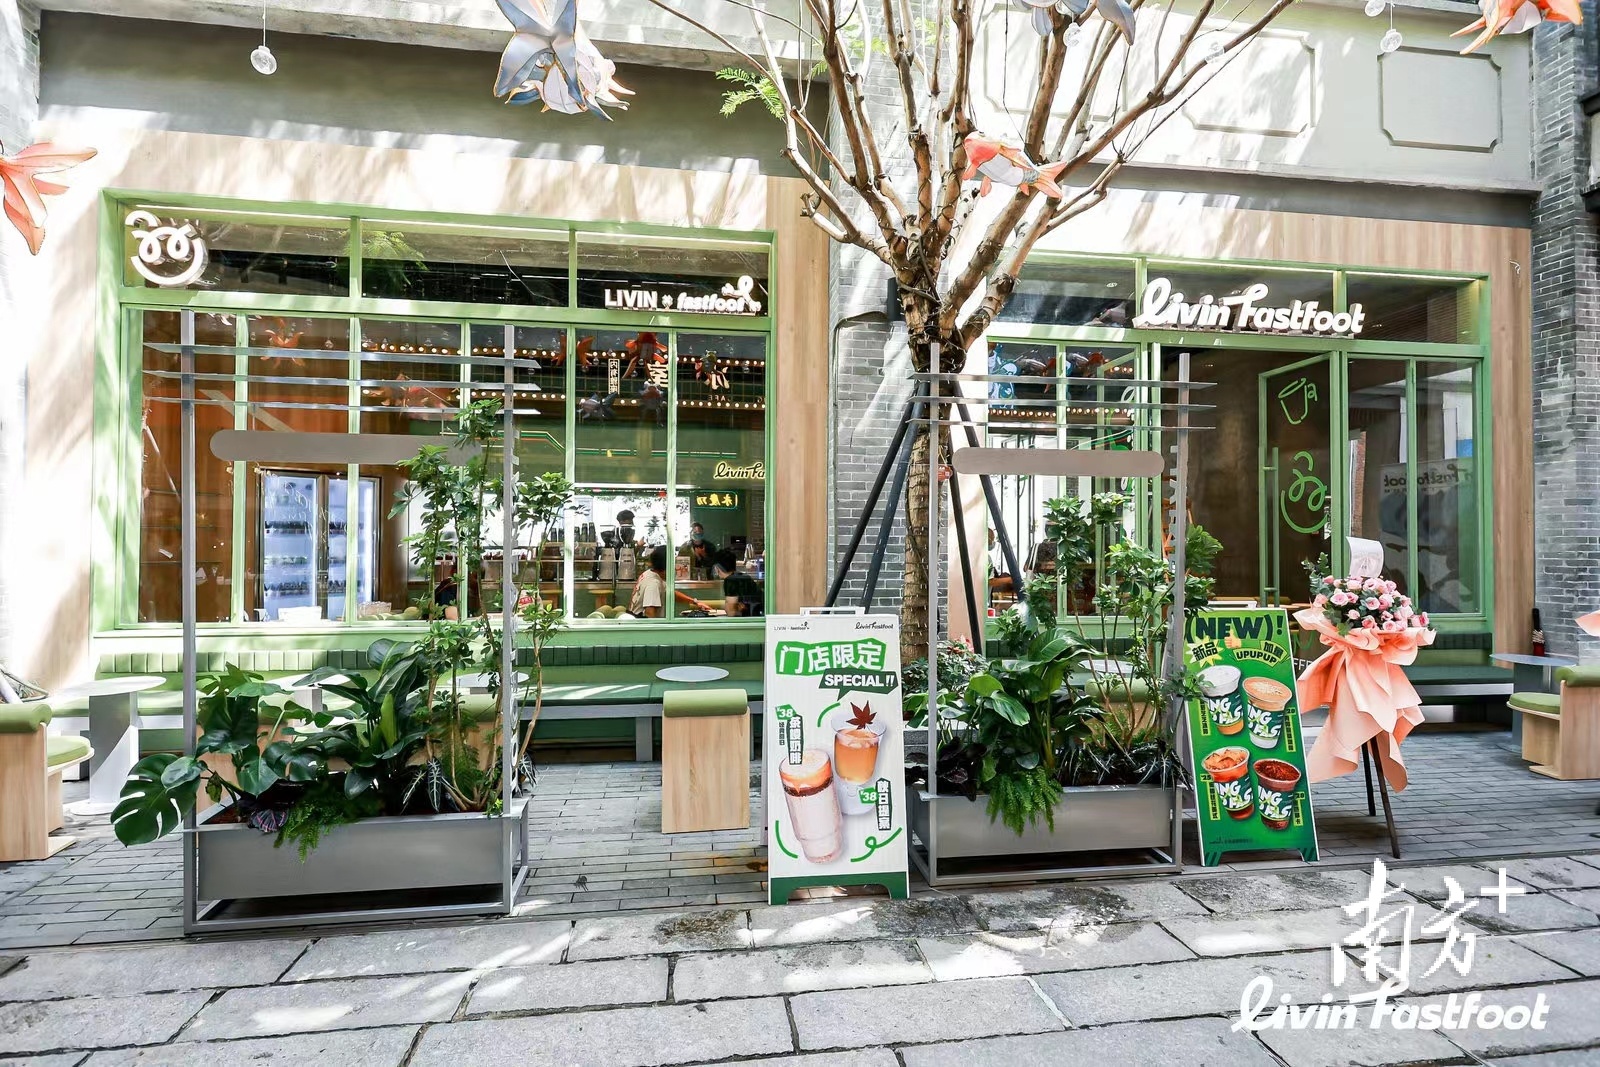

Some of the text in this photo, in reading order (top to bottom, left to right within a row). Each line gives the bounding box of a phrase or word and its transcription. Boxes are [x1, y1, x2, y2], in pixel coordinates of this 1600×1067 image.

[604, 288, 658, 308] LIVIN
[1219, 283, 1365, 333] Fastfoot
[779, 641, 882, 673] 门店限定
[1192, 642, 1218, 661] 新品
[1236, 650, 1278, 664] UPUPUP
